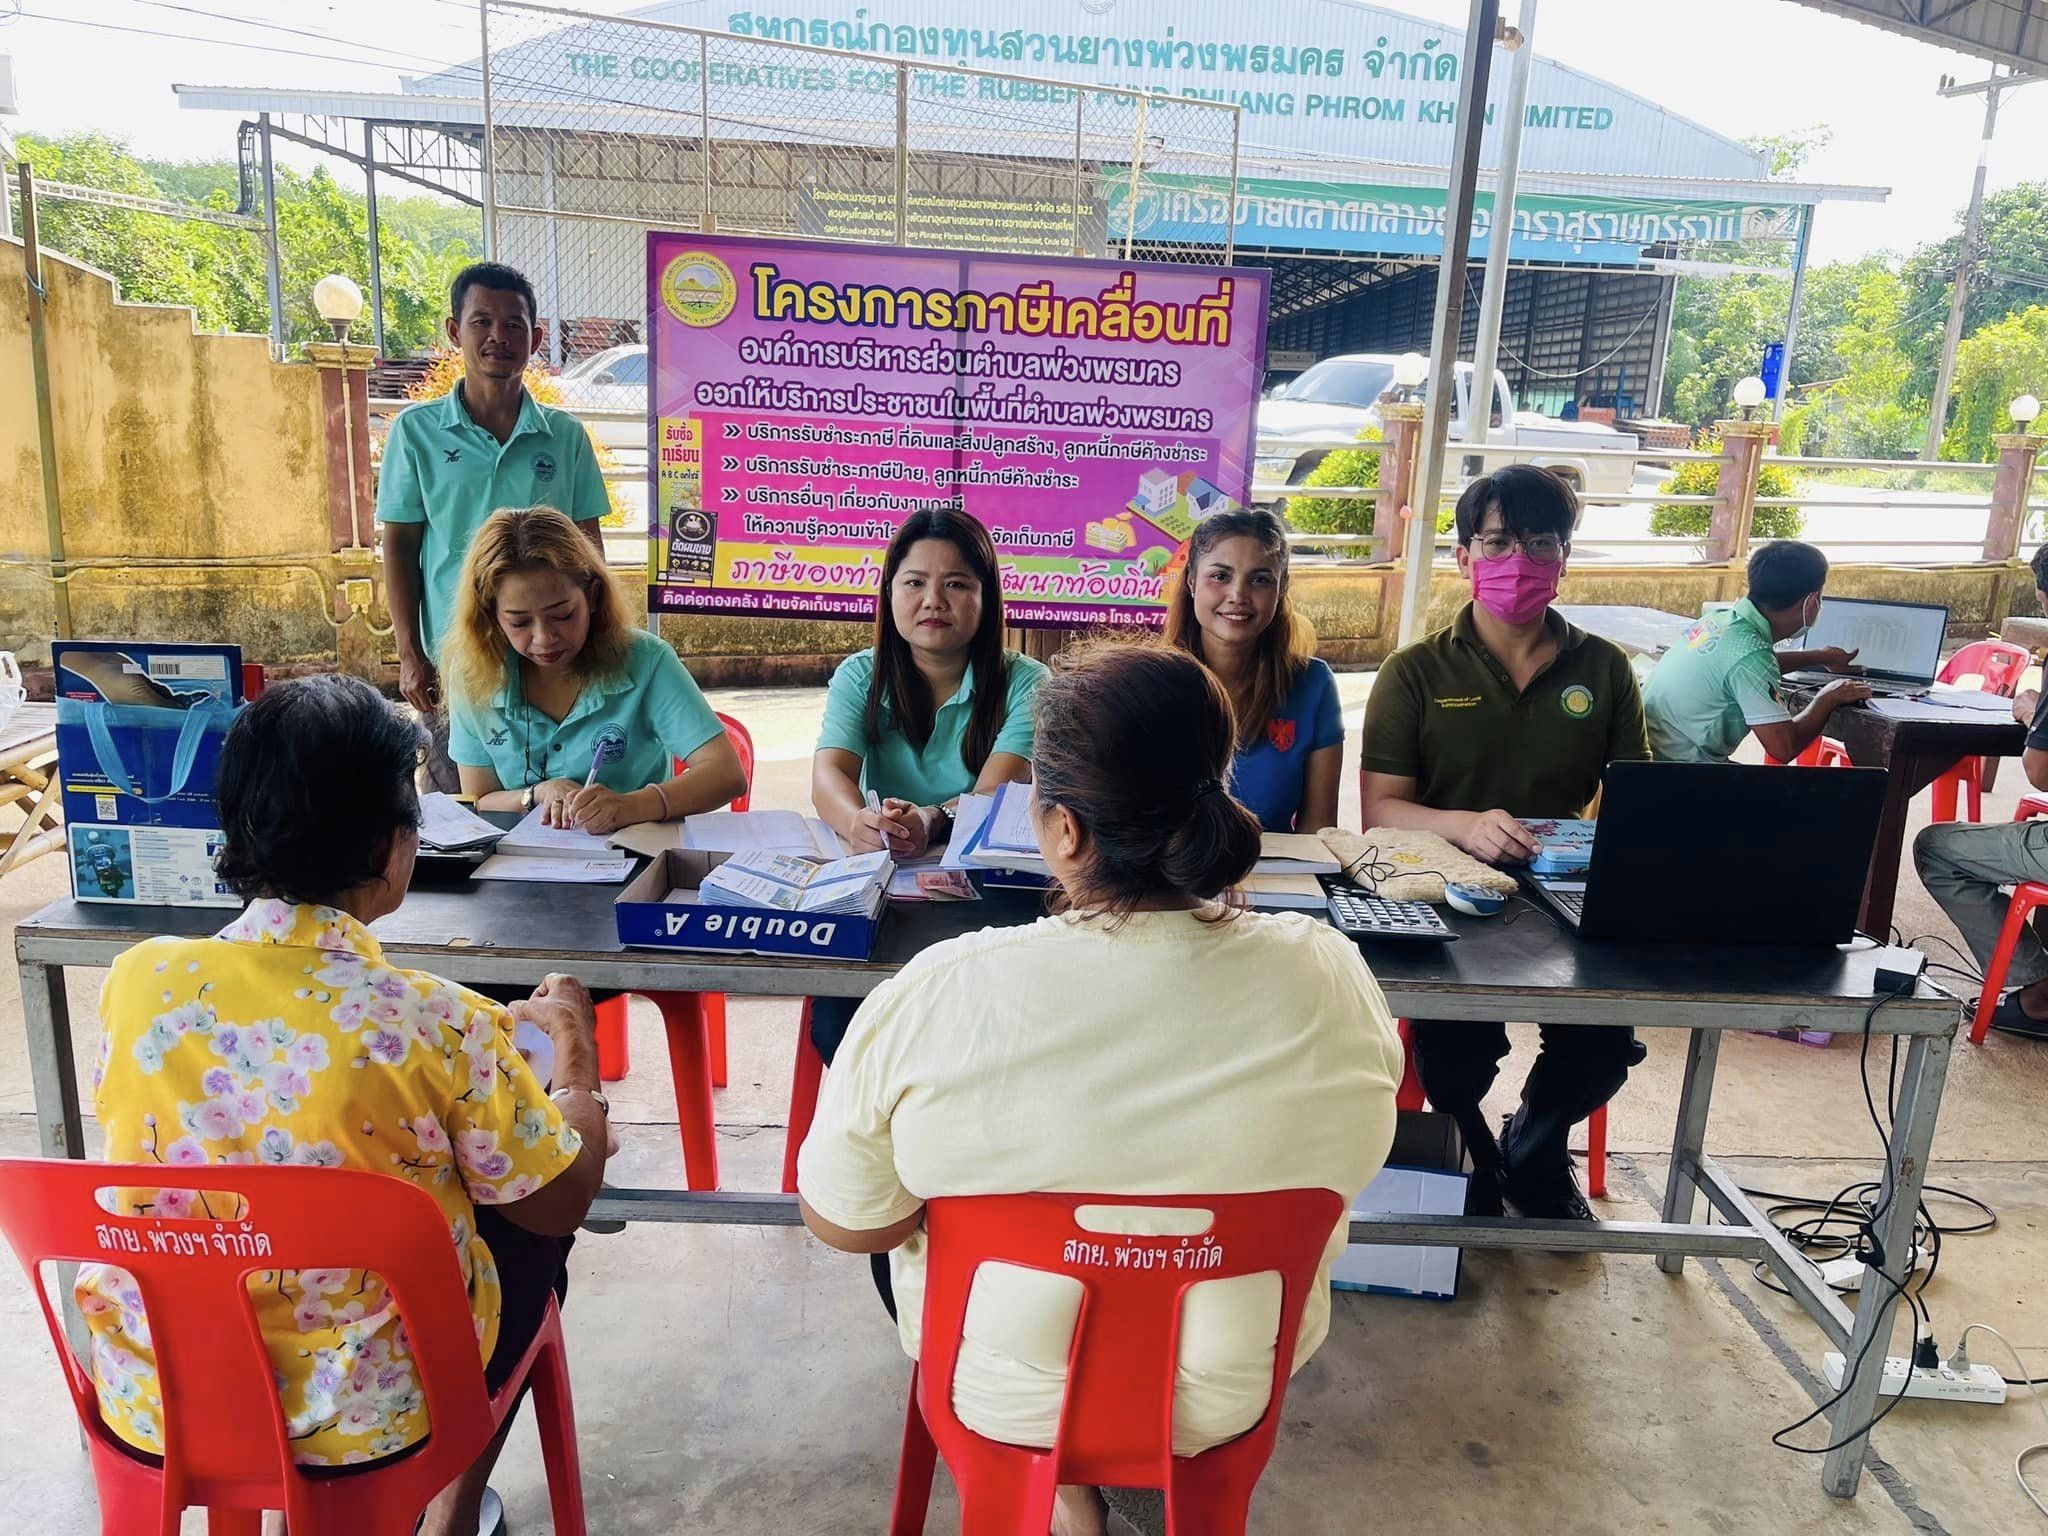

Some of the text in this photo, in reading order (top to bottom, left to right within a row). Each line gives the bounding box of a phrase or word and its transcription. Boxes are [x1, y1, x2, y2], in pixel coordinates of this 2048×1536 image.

[1363, 36, 1458, 81] จำกัด
[565, 53, 619, 78] THE
[631, 56, 836, 91] COOPERATIVES
[915, 73, 967, 98] THE
[1304, 94, 1405, 121] PHROM
[1418, 100, 1495, 125] KHN
[1523, 104, 1614, 130] IMITED
[751, 263, 1235, 347] โครงการภาษีเคลื่อนที่
[740, 333, 1180, 386] องค์การบริหารส่วนตำบลพ่วงพรมคร
[697, 381, 1213, 432] ออกให้บริการประชาชนในพื้นที่ตำบลพ่วงพรมคร
[662, 443, 700, 466] ทุเรียน
[748, 423, 1207, 462] บริการรับชำระภาษี ที่ดินและสิ่งปลูกสร้าง, ลูกหนี้ภาษีค้างชำระ
[746, 457, 1079, 488] บริการรับชำระภาษีป้าย, ลูกหนี้ภาษีค้างชำระ
[747, 483, 834, 510] บริการอื่นๆ
[731, 551, 883, 587] ภาษีของท่า
[1000, 561, 1164, 598] ัฒนาท้องถิ่น
[662, 589, 874, 614] ติดต่อกองคลัง ฝ่ายจัดเก็บรายได้
[1110, 608, 1168, 626] โทร.0-77
[705, 914, 836, 946] Double
[95, 1223, 148, 1254] สกย.
[211, 1221, 272, 1258] จำกัด
[1063, 1238, 1109, 1267] สกย.
[1172, 1236, 1223, 1269] จำกัด
